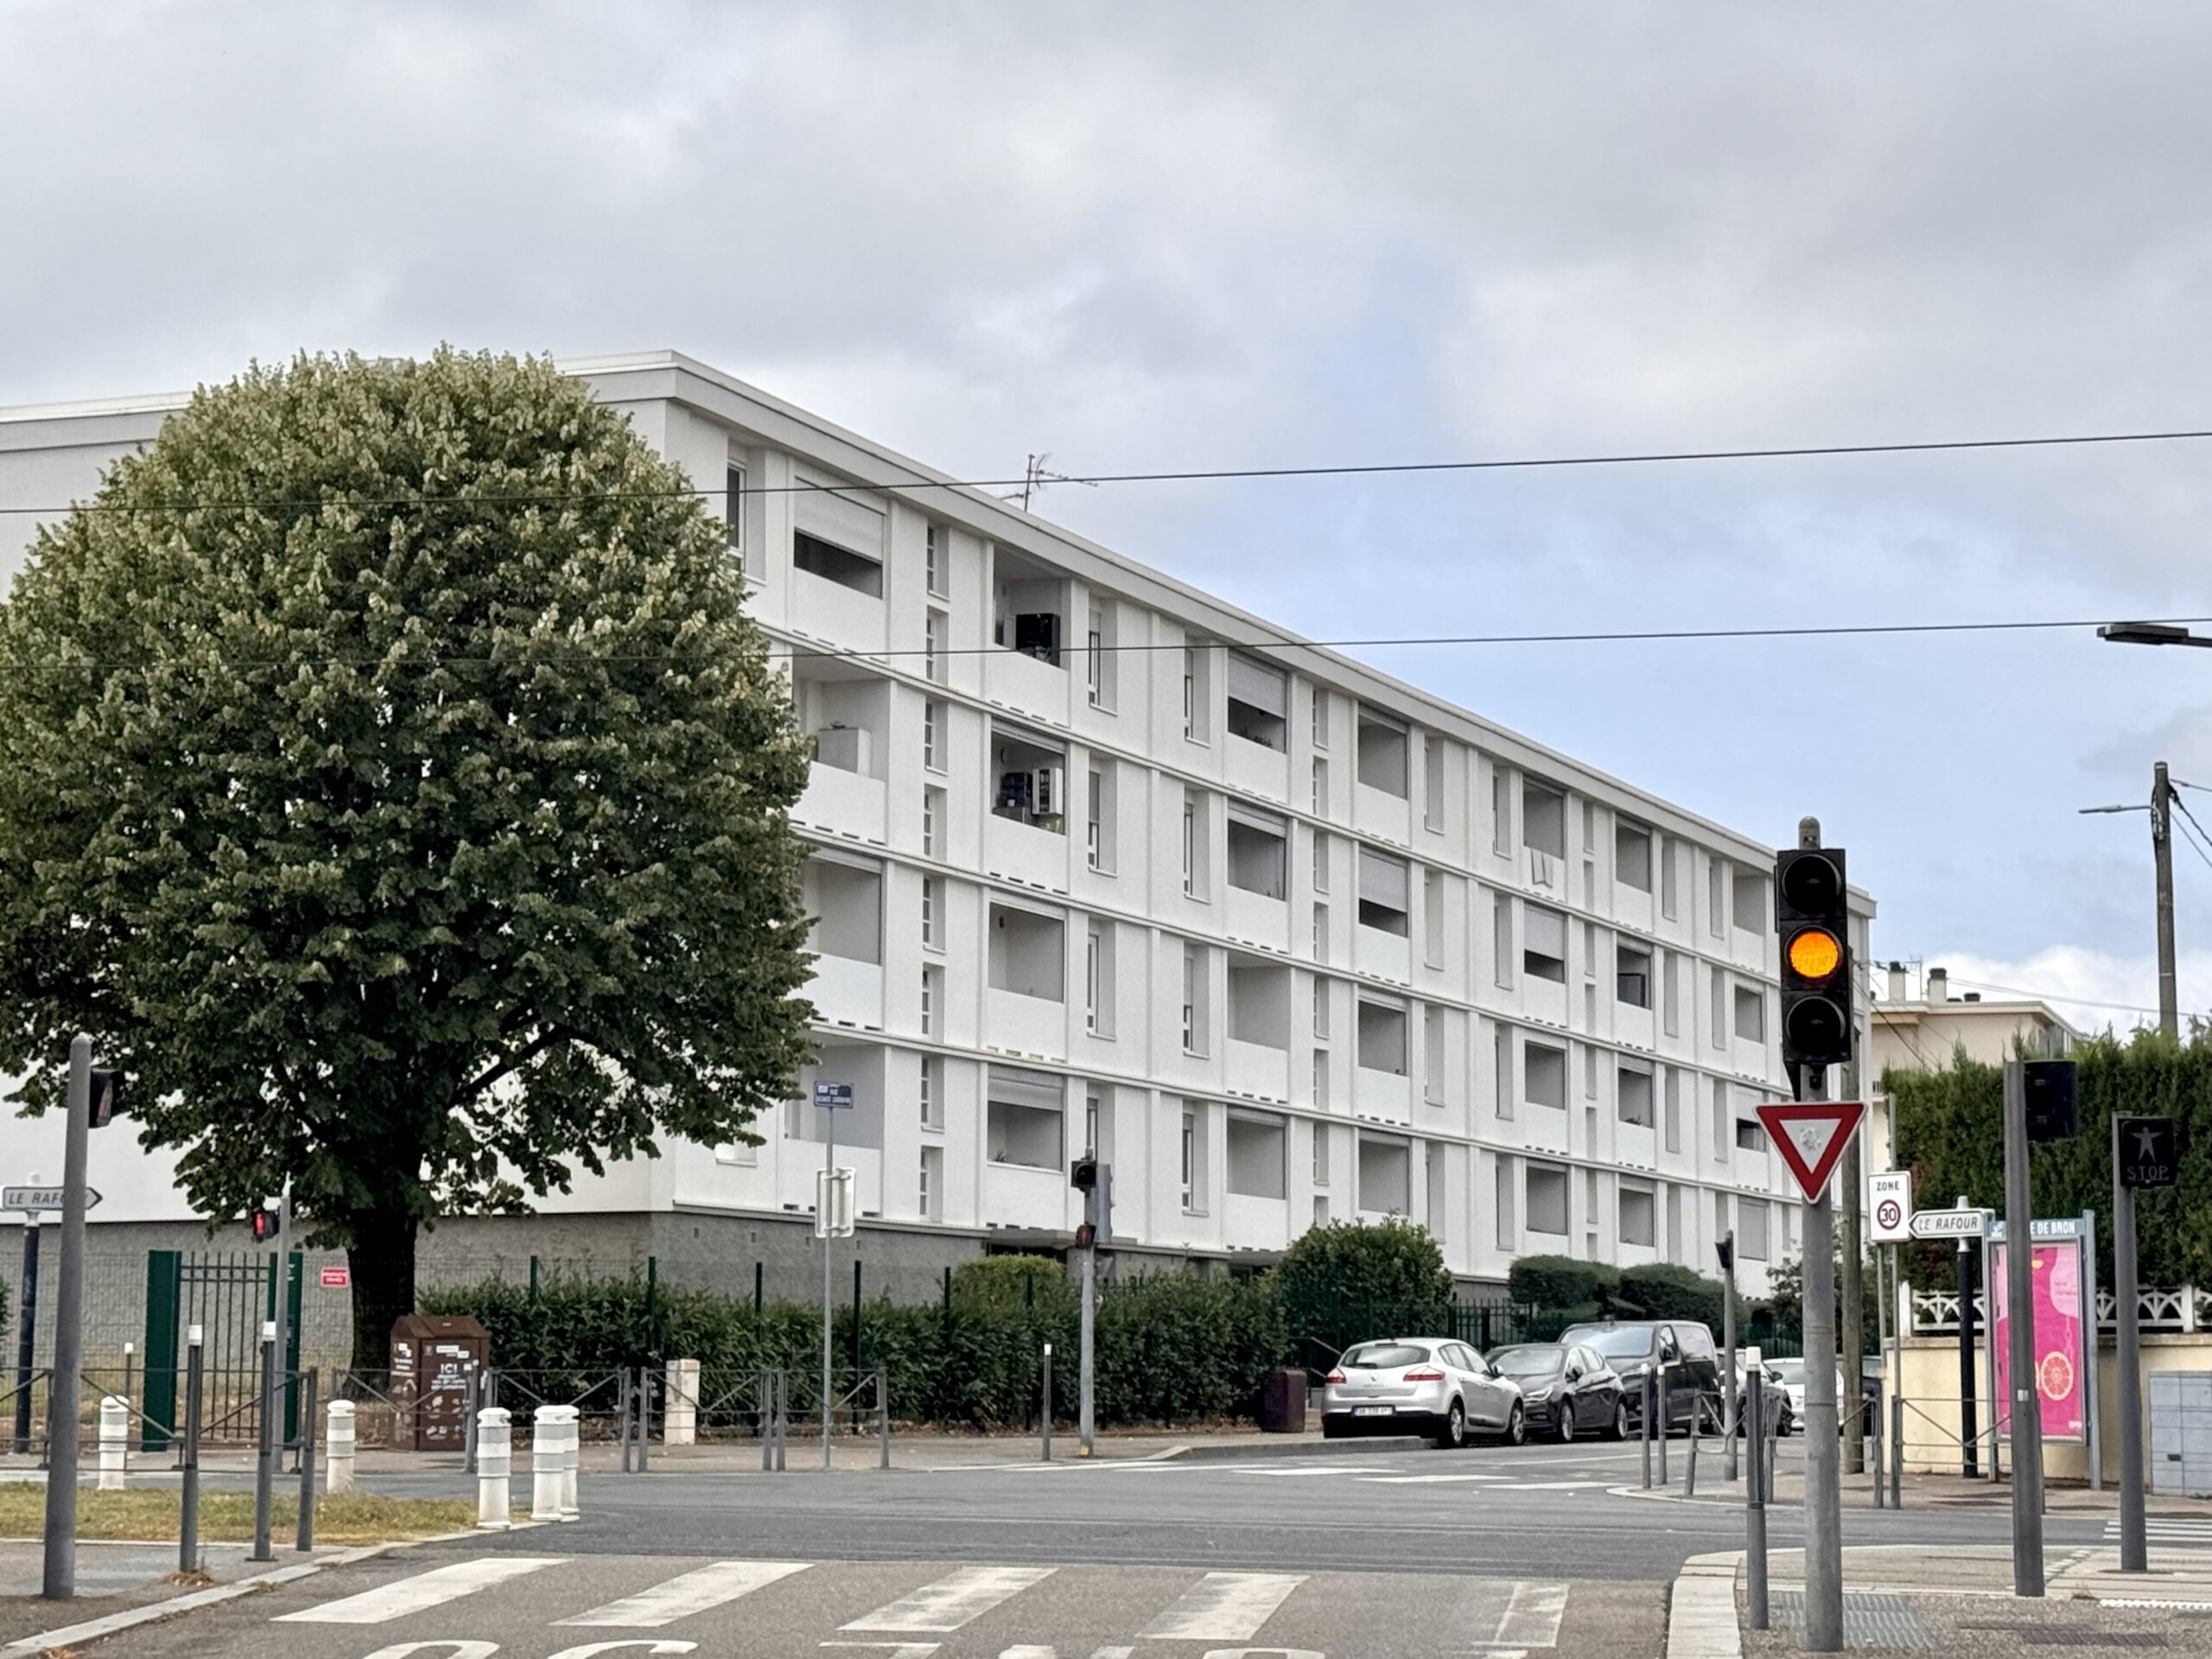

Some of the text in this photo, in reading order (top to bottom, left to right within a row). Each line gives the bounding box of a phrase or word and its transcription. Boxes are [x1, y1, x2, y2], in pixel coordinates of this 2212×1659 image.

[2126, 1165, 2169, 1181] STOP
[1876, 1181, 1900, 1192] ZONE
[9, 1192, 24, 1205] LE
[1880, 1208, 1897, 1222] 30
[1919, 1217, 1978, 1230] LE RAFOUR
[2037, 1221, 2050, 1235] DE
[2051, 1220, 2075, 1234] BRON
[441, 1363, 458, 1374] ICI
